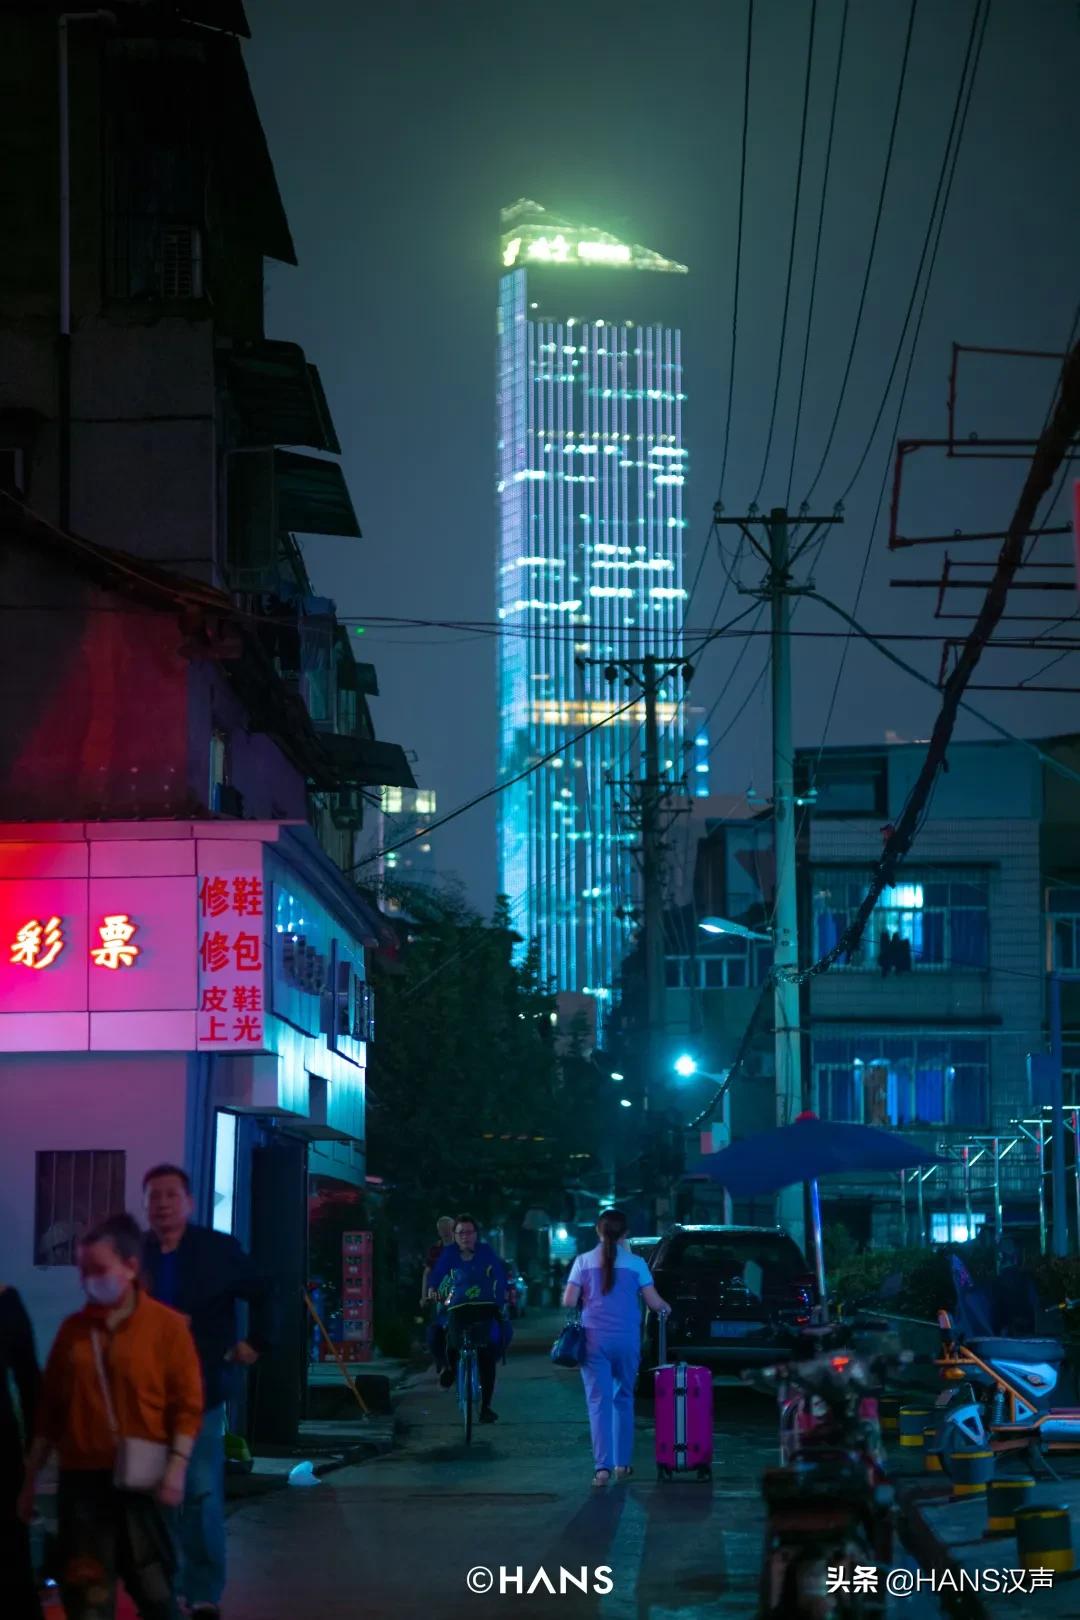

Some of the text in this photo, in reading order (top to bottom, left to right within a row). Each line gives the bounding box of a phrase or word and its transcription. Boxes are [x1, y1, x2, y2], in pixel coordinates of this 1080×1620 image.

[199, 876, 263, 918] 修鞋
[10, 915, 139, 969] 彩票
[200, 931, 262, 972] 修包
[200, 985, 262, 1013] 皮鞋
[200, 1016, 262, 1042] 上光
